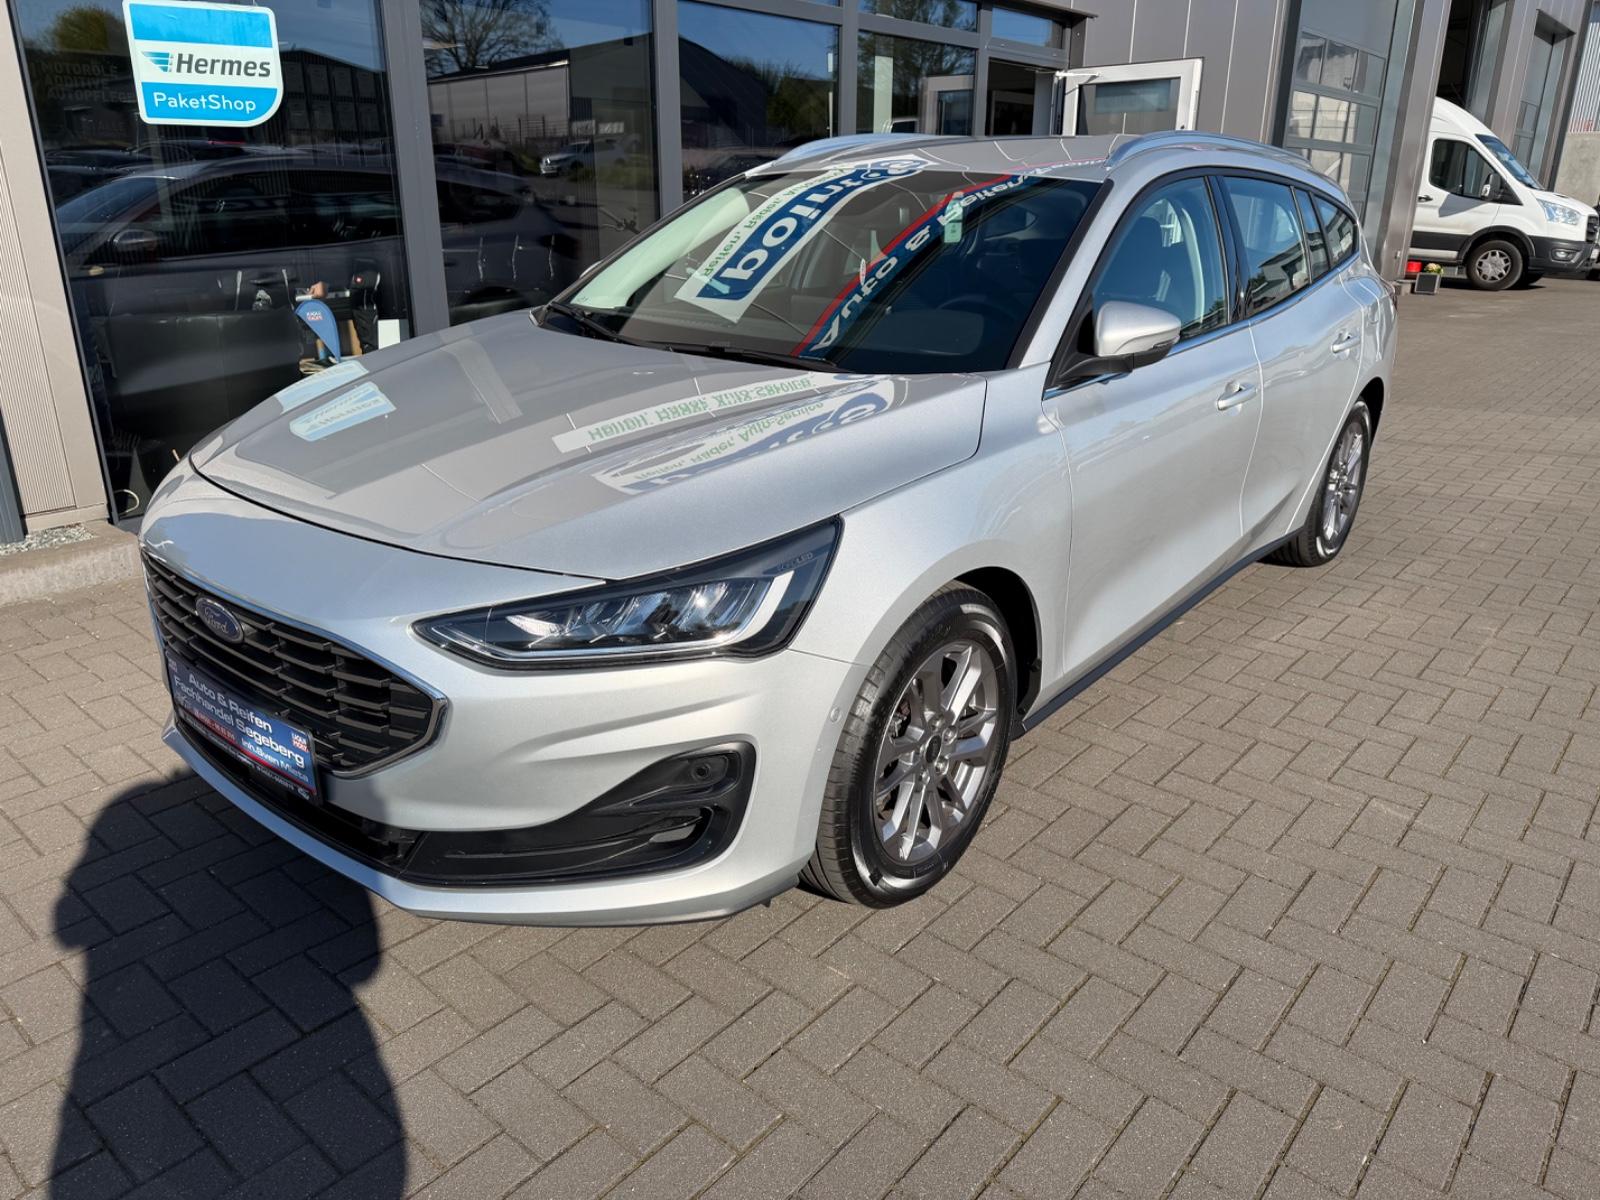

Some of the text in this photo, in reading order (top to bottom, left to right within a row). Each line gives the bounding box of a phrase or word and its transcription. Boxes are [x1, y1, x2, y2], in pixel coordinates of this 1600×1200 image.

[176, 53, 271, 78] Hermes
[153, 92, 257, 114] PaketShop
[174, 675, 234, 726] Fachhandel
[236, 718, 305, 769] Segeberg
[189, 673, 215, 700] Auto
[217, 692, 229, 708] &
[228, 699, 273, 734] Reifen
